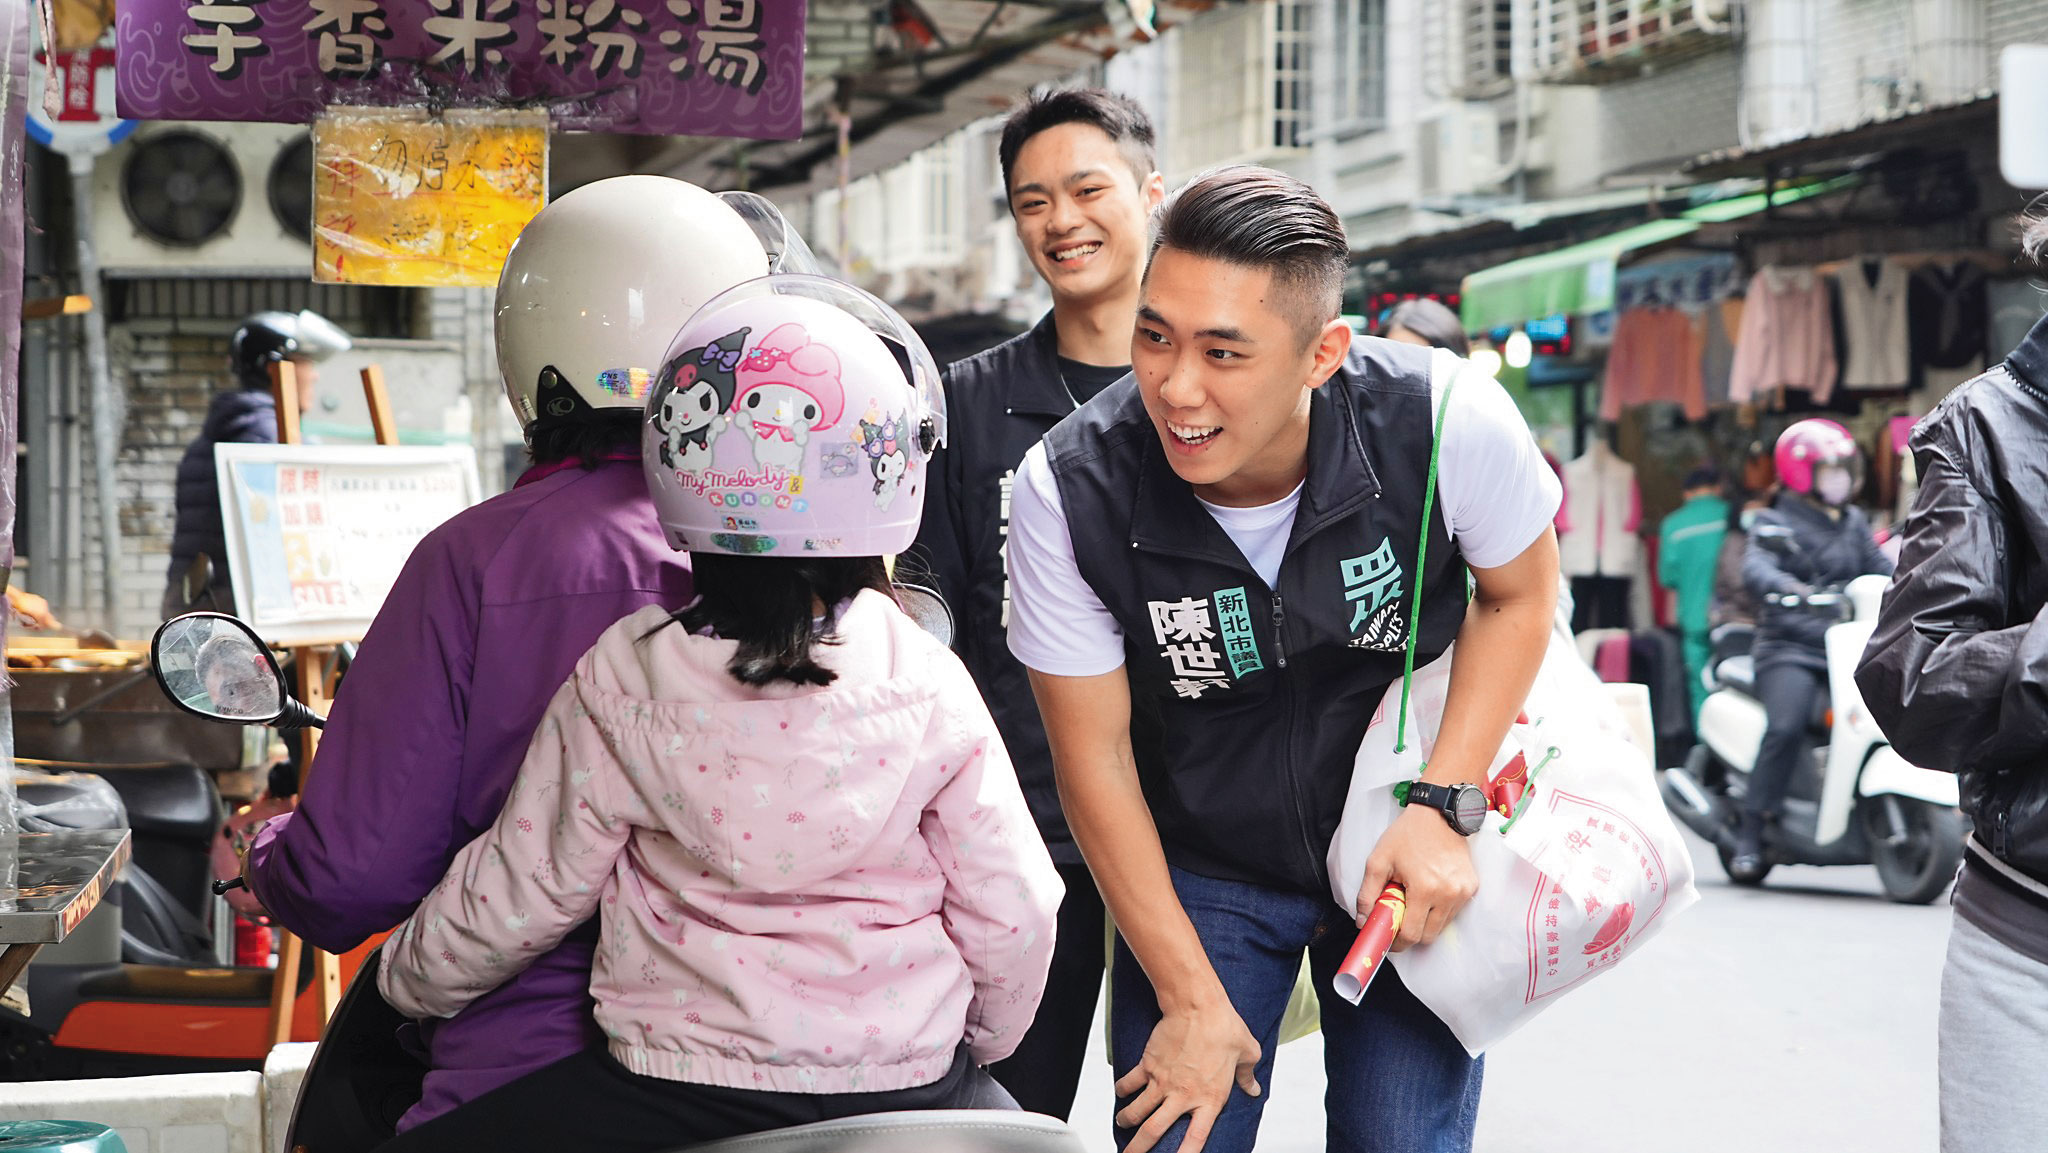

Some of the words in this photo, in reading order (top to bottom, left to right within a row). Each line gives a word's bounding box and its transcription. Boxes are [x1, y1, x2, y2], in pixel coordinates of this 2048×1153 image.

[601, 372, 619, 380] CNS
[676, 470, 709, 496] My
[704, 465, 791, 492] Melody
[790, 476, 803, 494] &
[709, 492, 809, 512] KUROMI
[1219, 593, 1258, 674] 新北市議員
[1350, 600, 1401, 645] TAIWAN
